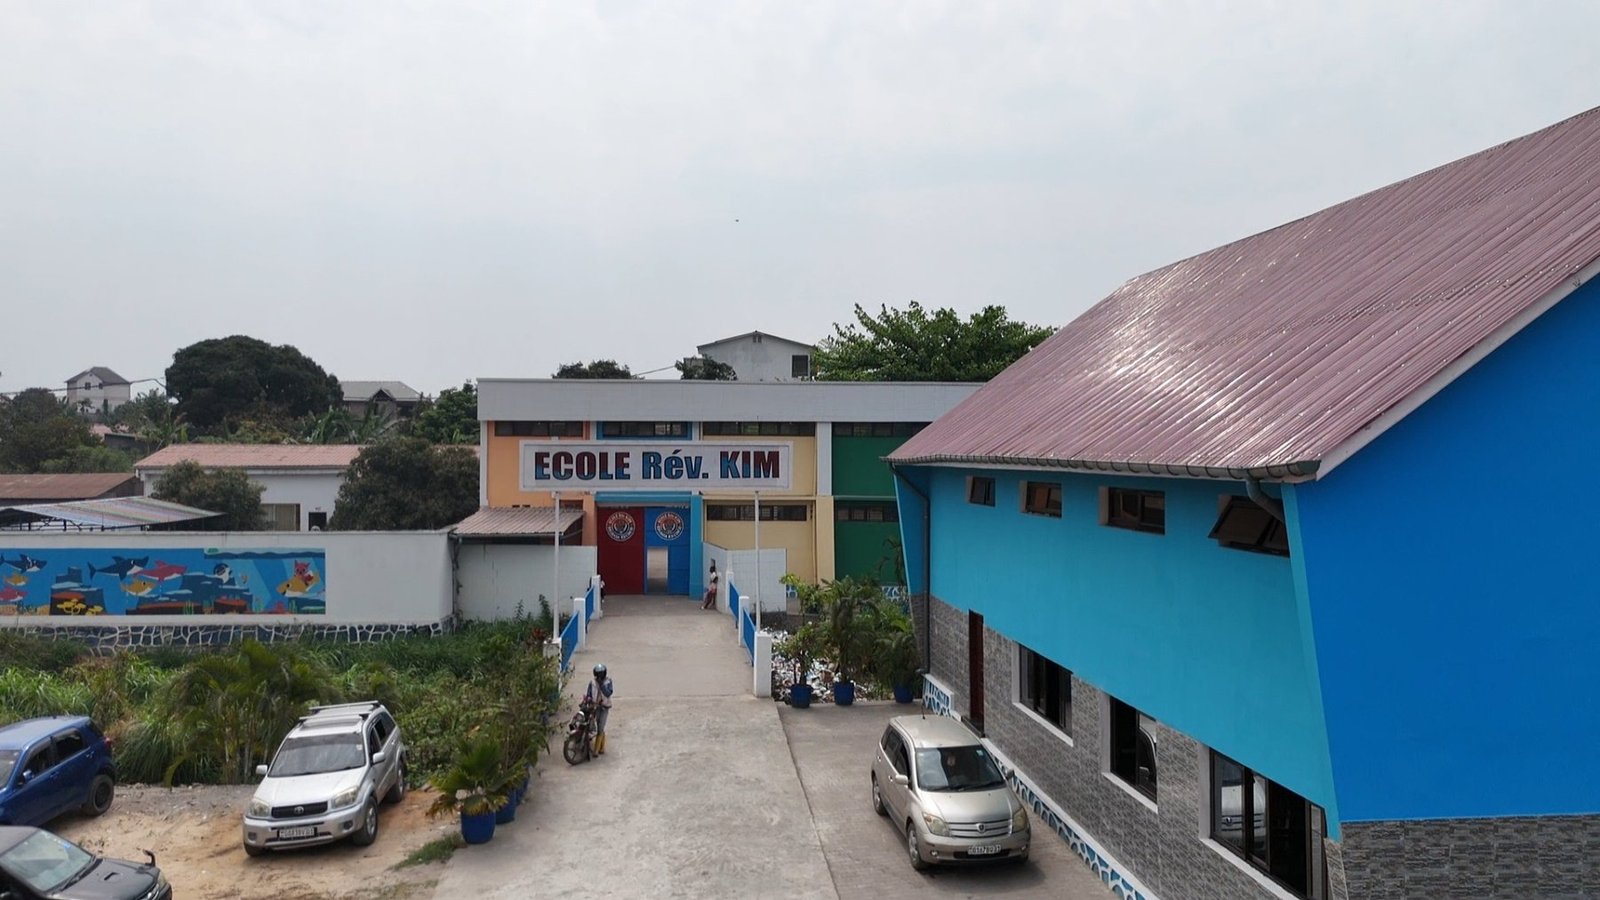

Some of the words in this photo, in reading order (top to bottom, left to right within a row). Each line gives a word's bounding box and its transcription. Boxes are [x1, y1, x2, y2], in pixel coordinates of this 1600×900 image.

[534, 451, 631, 481] ECOLE
[641, 448, 709, 480] Rév.
[719, 450, 780, 479] KIM
